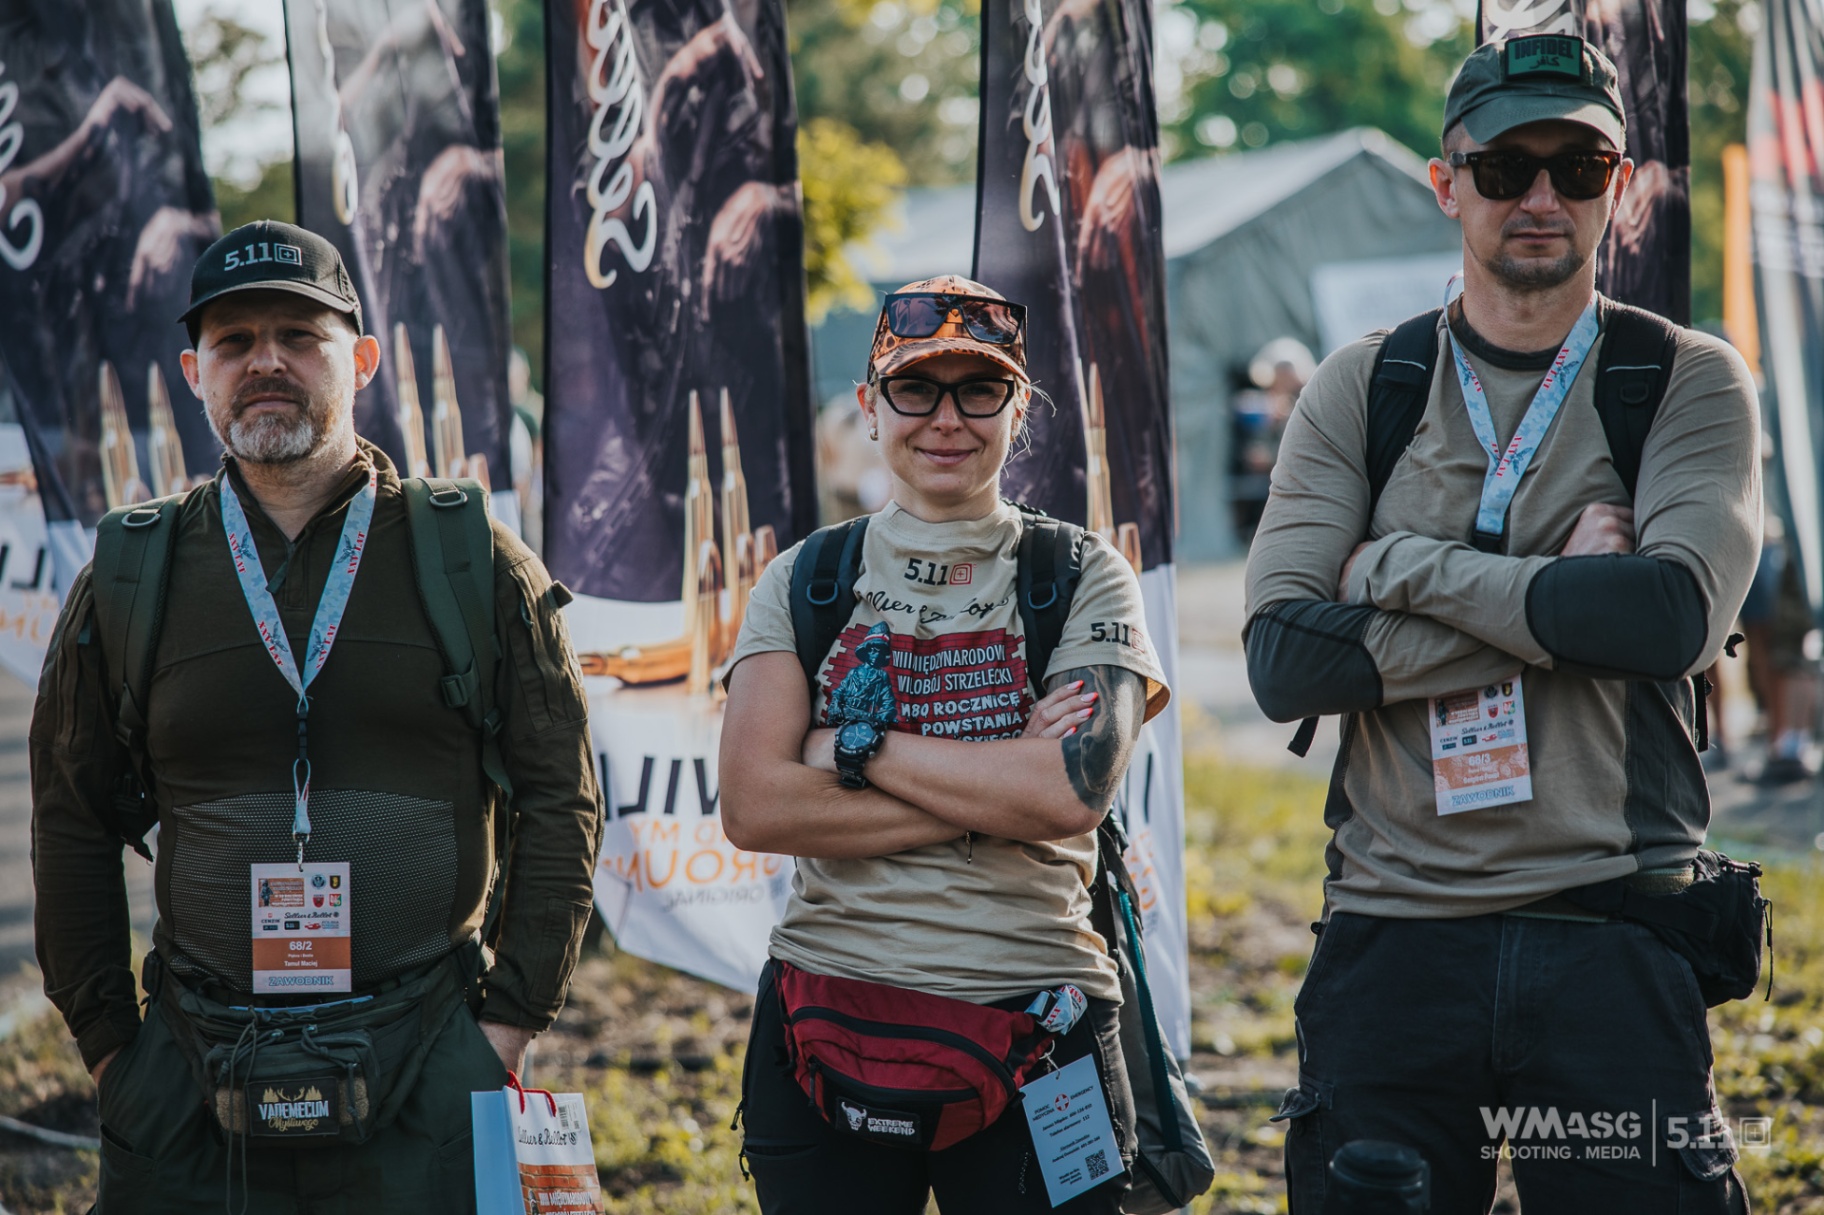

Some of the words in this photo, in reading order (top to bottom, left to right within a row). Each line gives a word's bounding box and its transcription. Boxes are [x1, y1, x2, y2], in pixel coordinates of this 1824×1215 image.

[1514, 39, 1574, 60] INFIDEL
[224, 242, 273, 271] 5.11
[904, 558, 950, 586] 5.11
[1091, 622, 1131, 648] 5.11
[944, 667, 1013, 692] STRZELECKI
[933, 690, 1021, 717] ROCZNICĘ
[921, 711, 1023, 738] POWSTANIA
[1452, 787, 1514, 805] ZAWODNIK
[289, 941, 313, 951] 68/2
[269, 976, 334, 986] ZAWODNIK
[258, 1100, 329, 1120] VADEMECUM
[867, 1125, 915, 1135] WEEKEND
[868, 1118, 913, 1127] EXTREME
